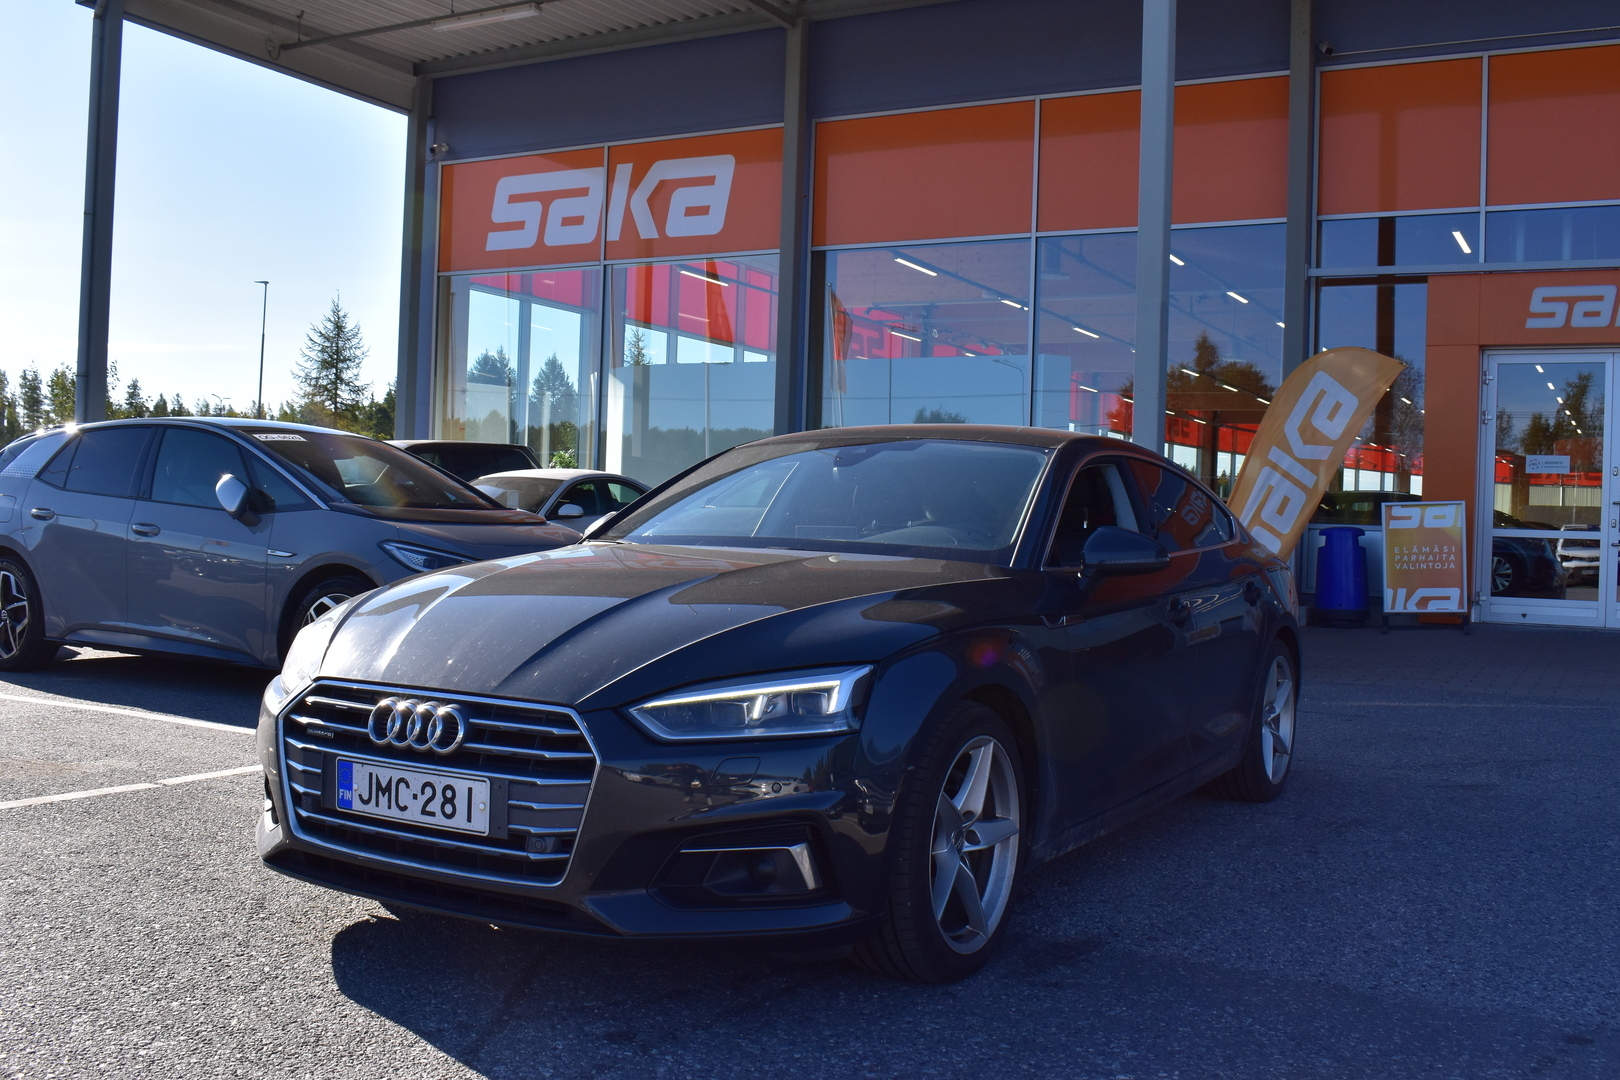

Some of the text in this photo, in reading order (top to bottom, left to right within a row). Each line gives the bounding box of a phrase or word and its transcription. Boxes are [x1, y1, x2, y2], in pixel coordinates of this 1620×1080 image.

[485, 154, 736, 251] saka
[1525, 284, 1620, 329] sa
[1389, 505, 1463, 529] sa
[1394, 545, 1455, 553] ELÄMÄSI
[339, 788, 352, 801] FIN
[358, 772, 473, 823] JMC-281
